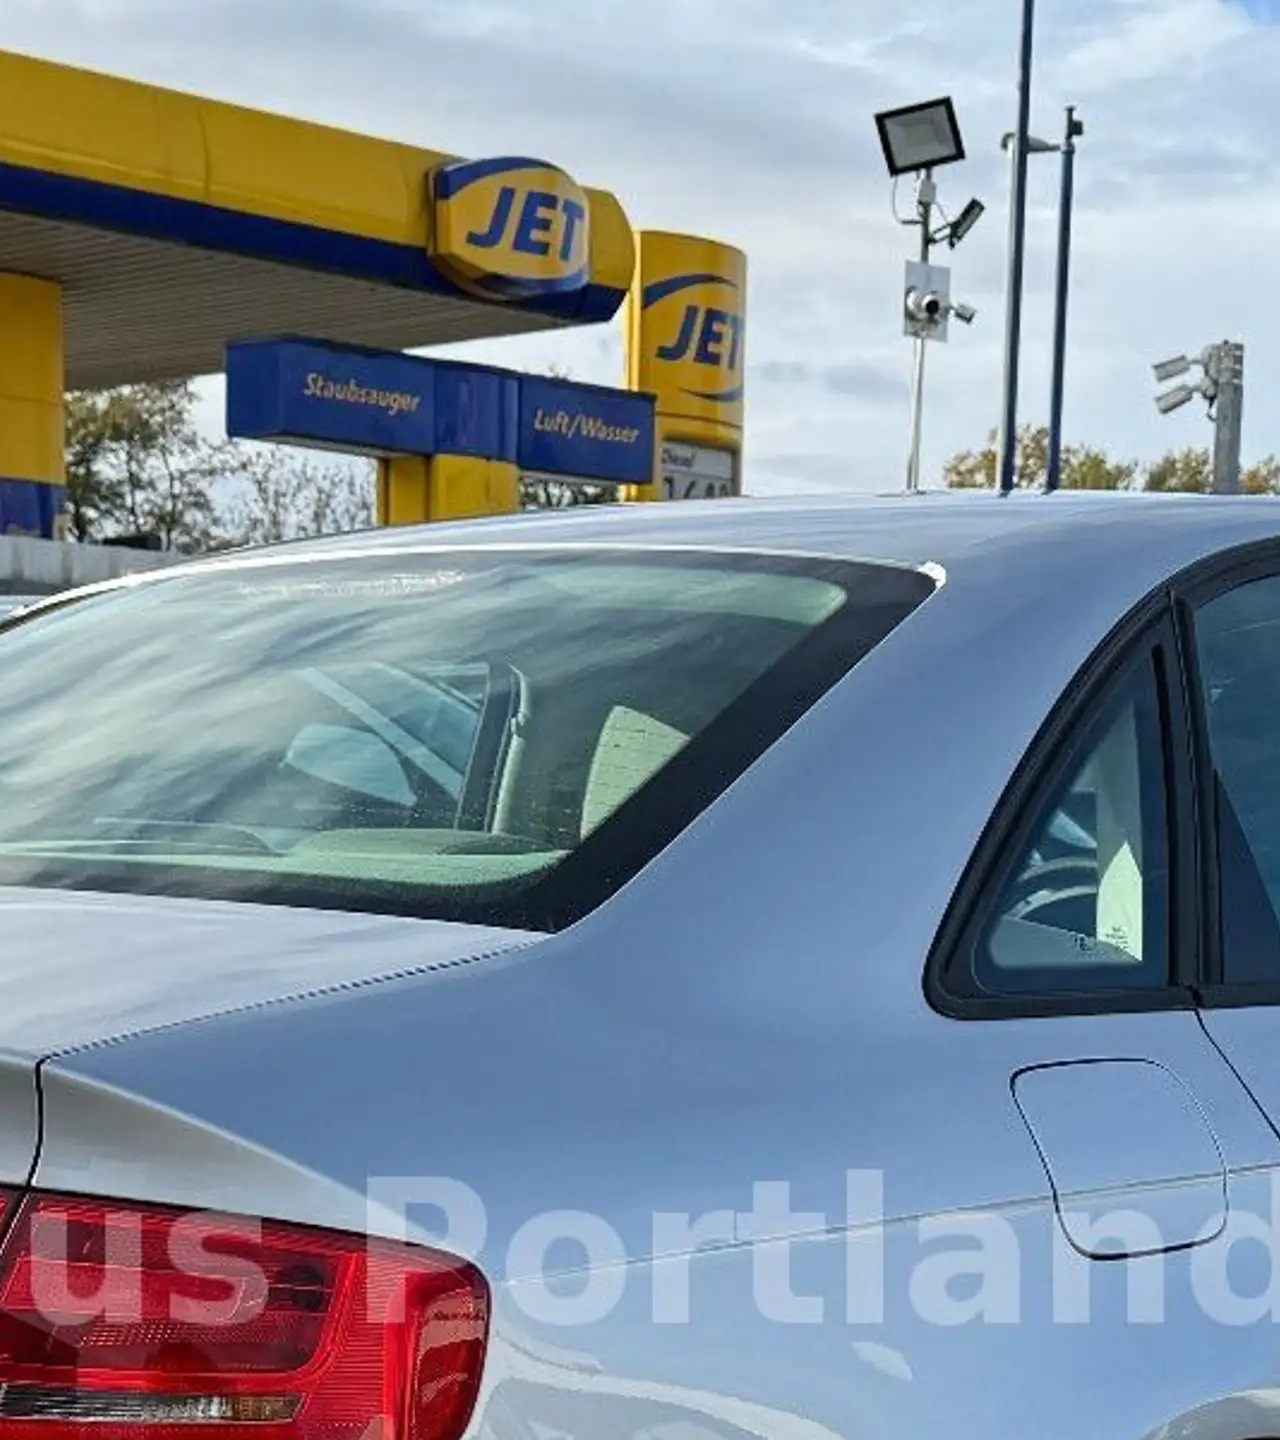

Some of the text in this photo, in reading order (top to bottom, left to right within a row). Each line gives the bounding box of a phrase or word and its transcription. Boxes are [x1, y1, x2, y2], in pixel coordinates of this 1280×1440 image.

[466, 185, 585, 262] JET
[656, 305, 743, 370] JET
[303, 372, 422, 414] Staubsauger
[533, 407, 640, 444] Luft/Wasser
